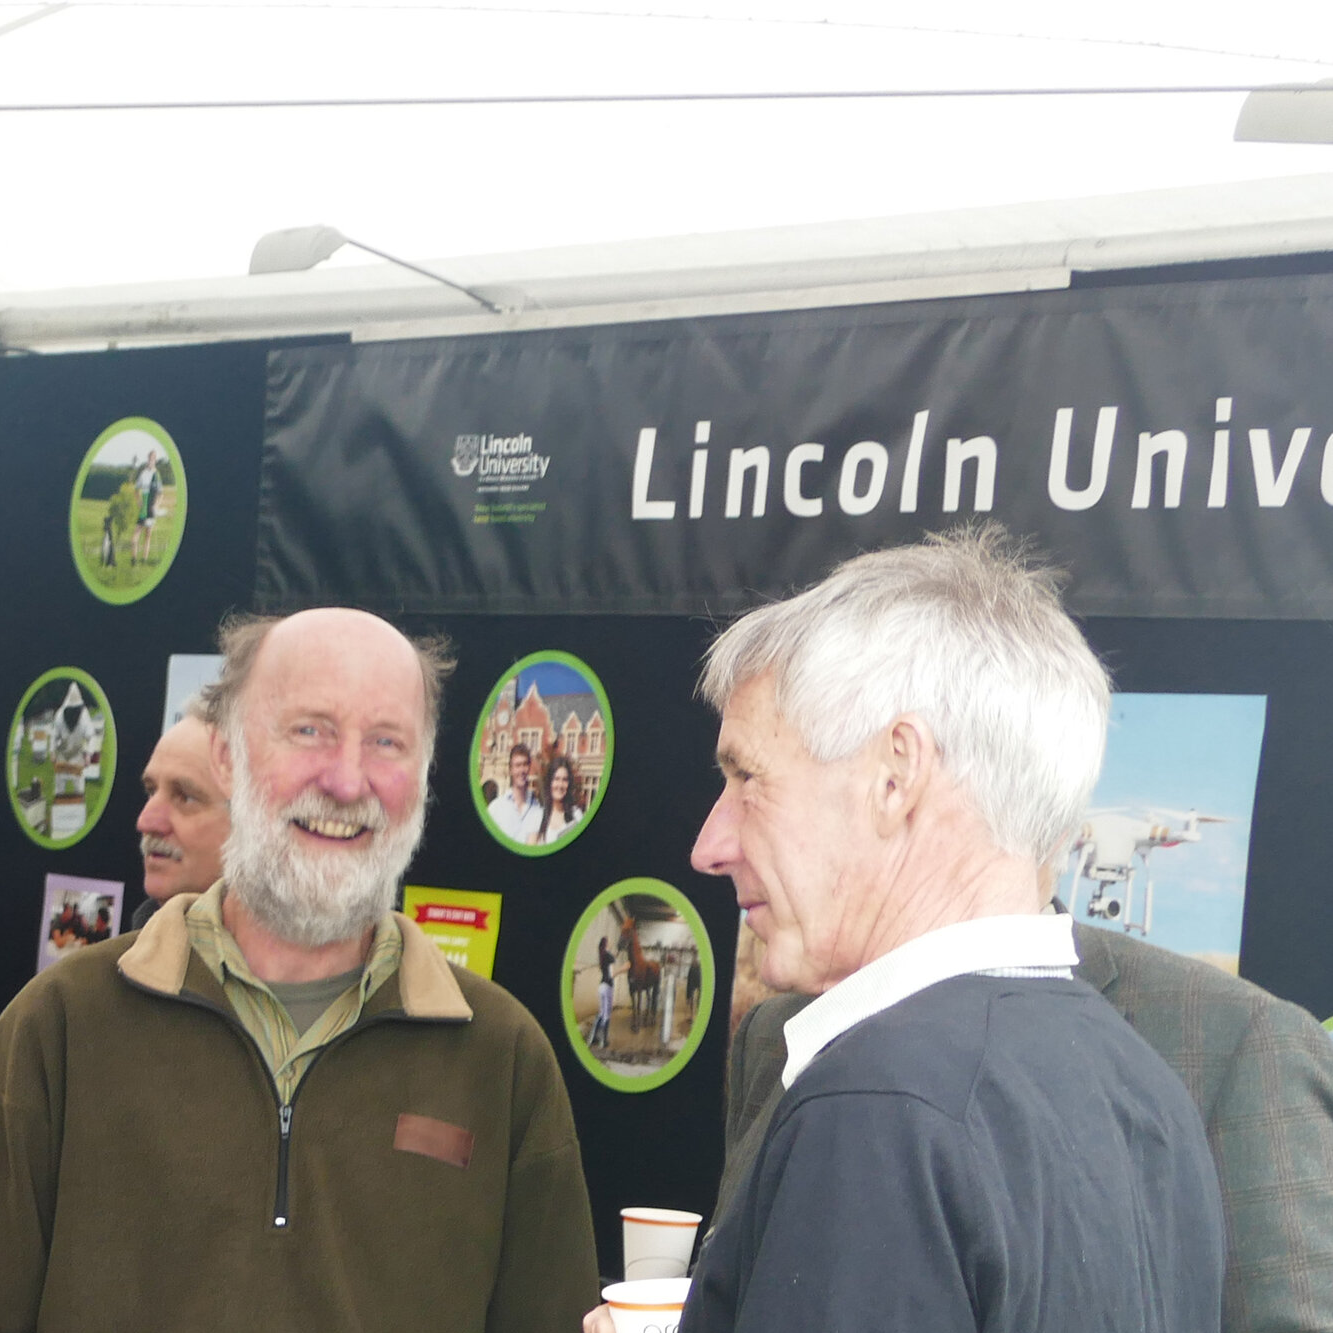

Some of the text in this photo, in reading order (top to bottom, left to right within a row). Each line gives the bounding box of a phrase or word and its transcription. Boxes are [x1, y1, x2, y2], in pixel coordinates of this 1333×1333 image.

[479, 432, 533, 455] Lincoln
[478, 452, 551, 479] University
[631, 396, 1333, 520] Lincoln Univ
